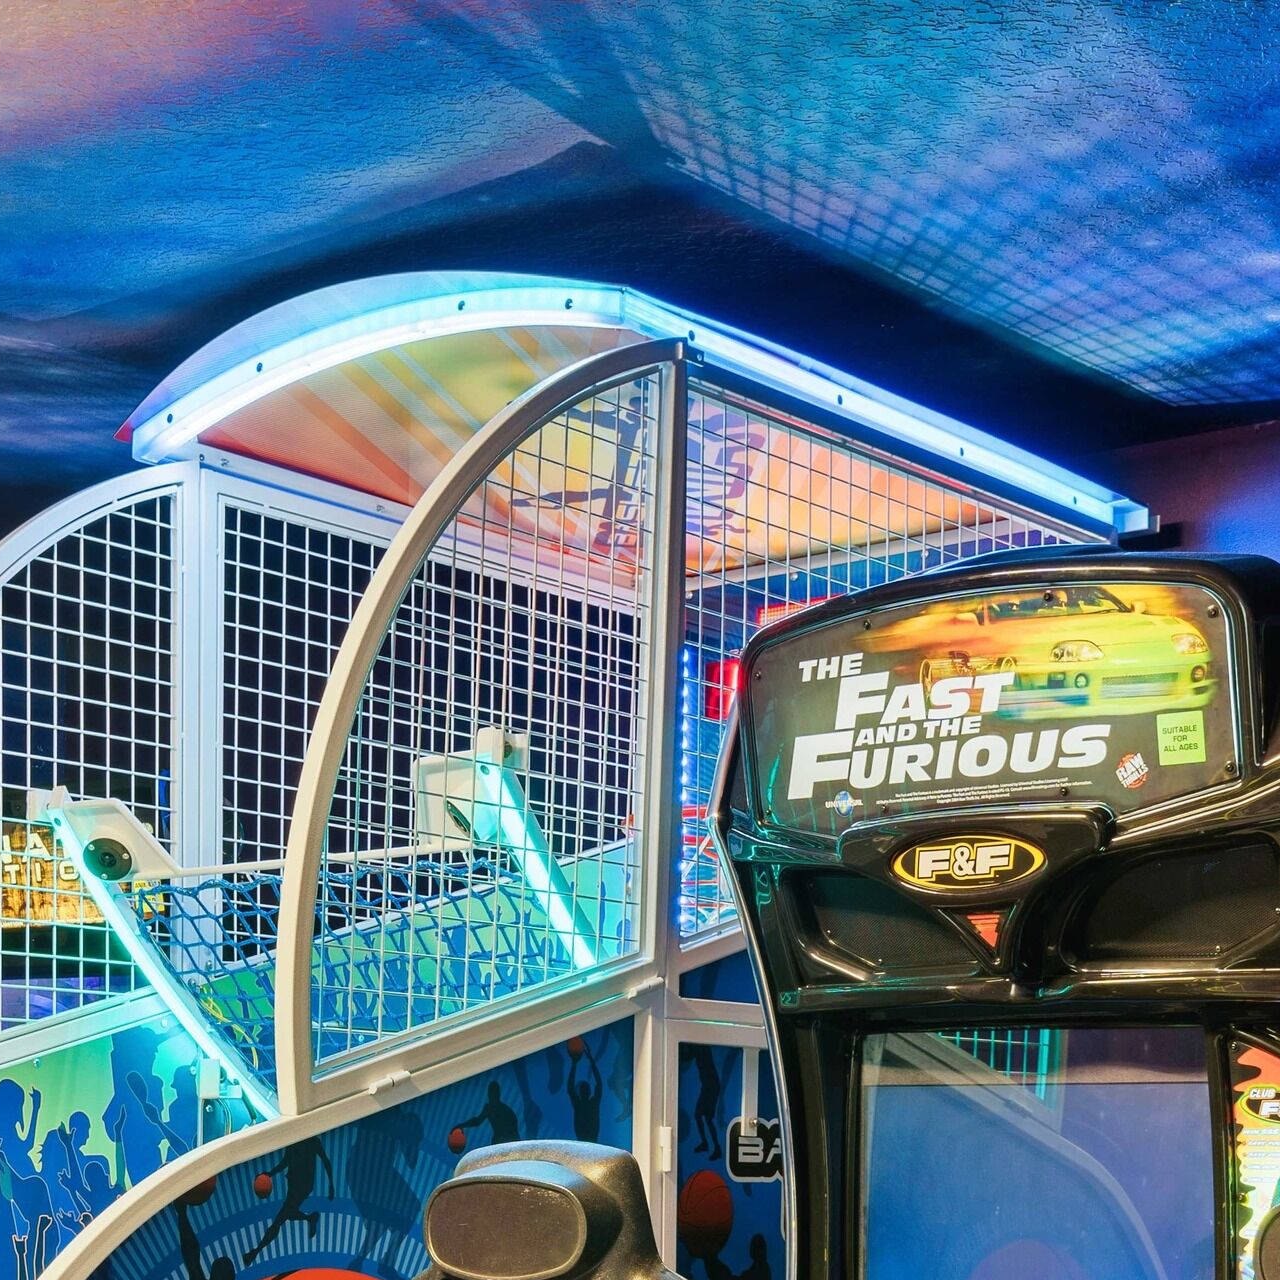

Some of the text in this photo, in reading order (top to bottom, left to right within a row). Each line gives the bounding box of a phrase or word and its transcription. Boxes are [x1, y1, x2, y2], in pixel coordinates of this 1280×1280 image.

[798, 652, 863, 682] THE
[834, 672, 1015, 730] FAST
[855, 715, 983, 747] AND THE
[1162, 725, 1198, 735] SUITABLE
[1179, 742, 1199, 751] AGES
[787, 724, 1111, 800] FURIOUS
[1115, 752, 1145, 782] RAW
[917, 843, 1012, 878] F&F
[1248, 1088, 1276, 1099] CLUB
